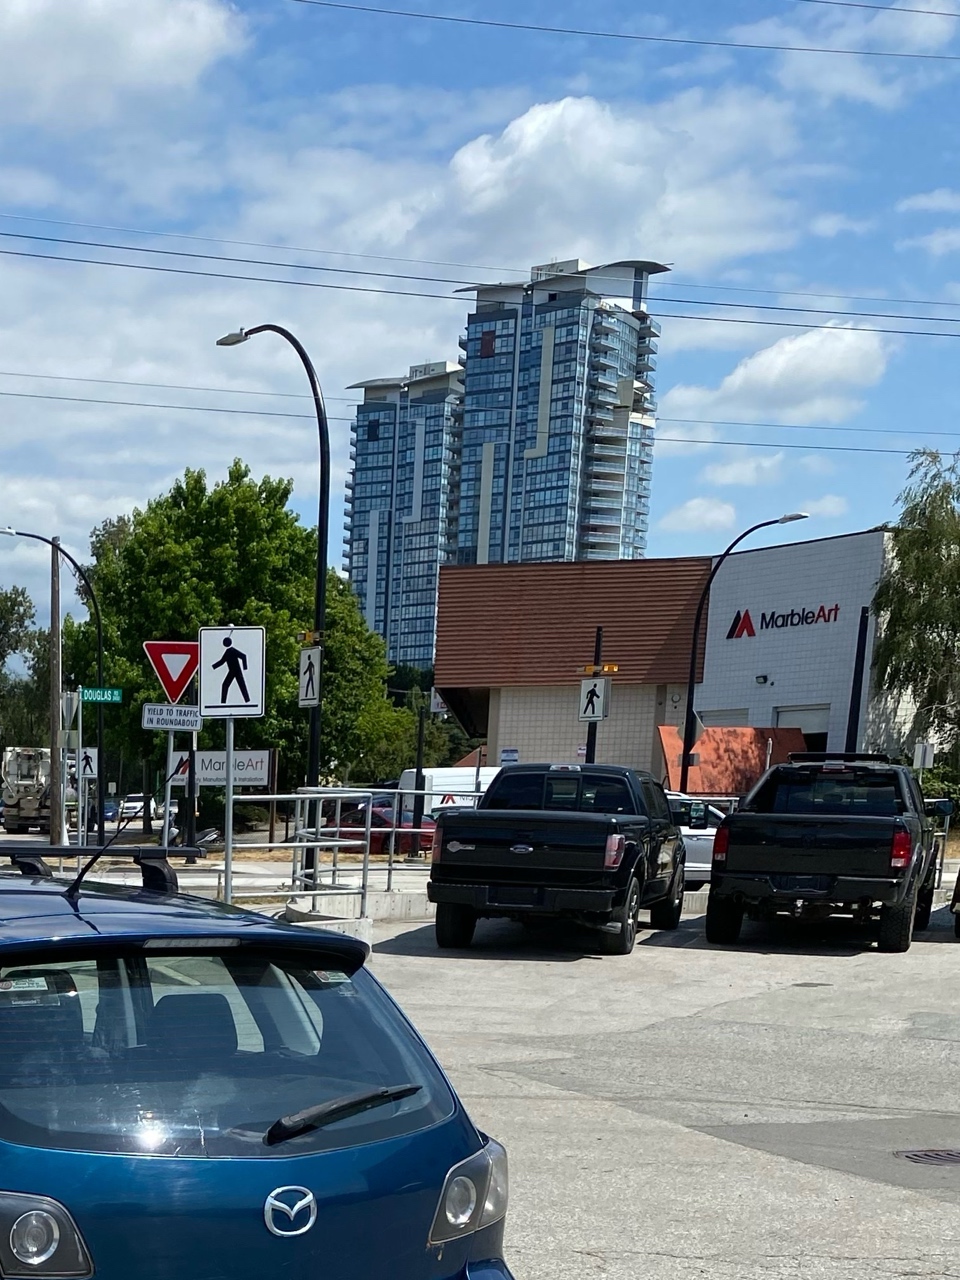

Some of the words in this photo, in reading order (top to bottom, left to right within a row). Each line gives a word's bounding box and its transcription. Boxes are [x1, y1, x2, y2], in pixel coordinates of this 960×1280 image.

[760, 603, 840, 630] MarbleArt
[83, 689, 112, 701] DOUGLAS
[147, 707, 164, 716] YIELD
[166, 708, 174, 717] TO
[176, 709, 199, 718] TRAFFIC
[156, 718, 199, 728] ROUNDABOUT
[201, 758, 264, 771] MarleArt
